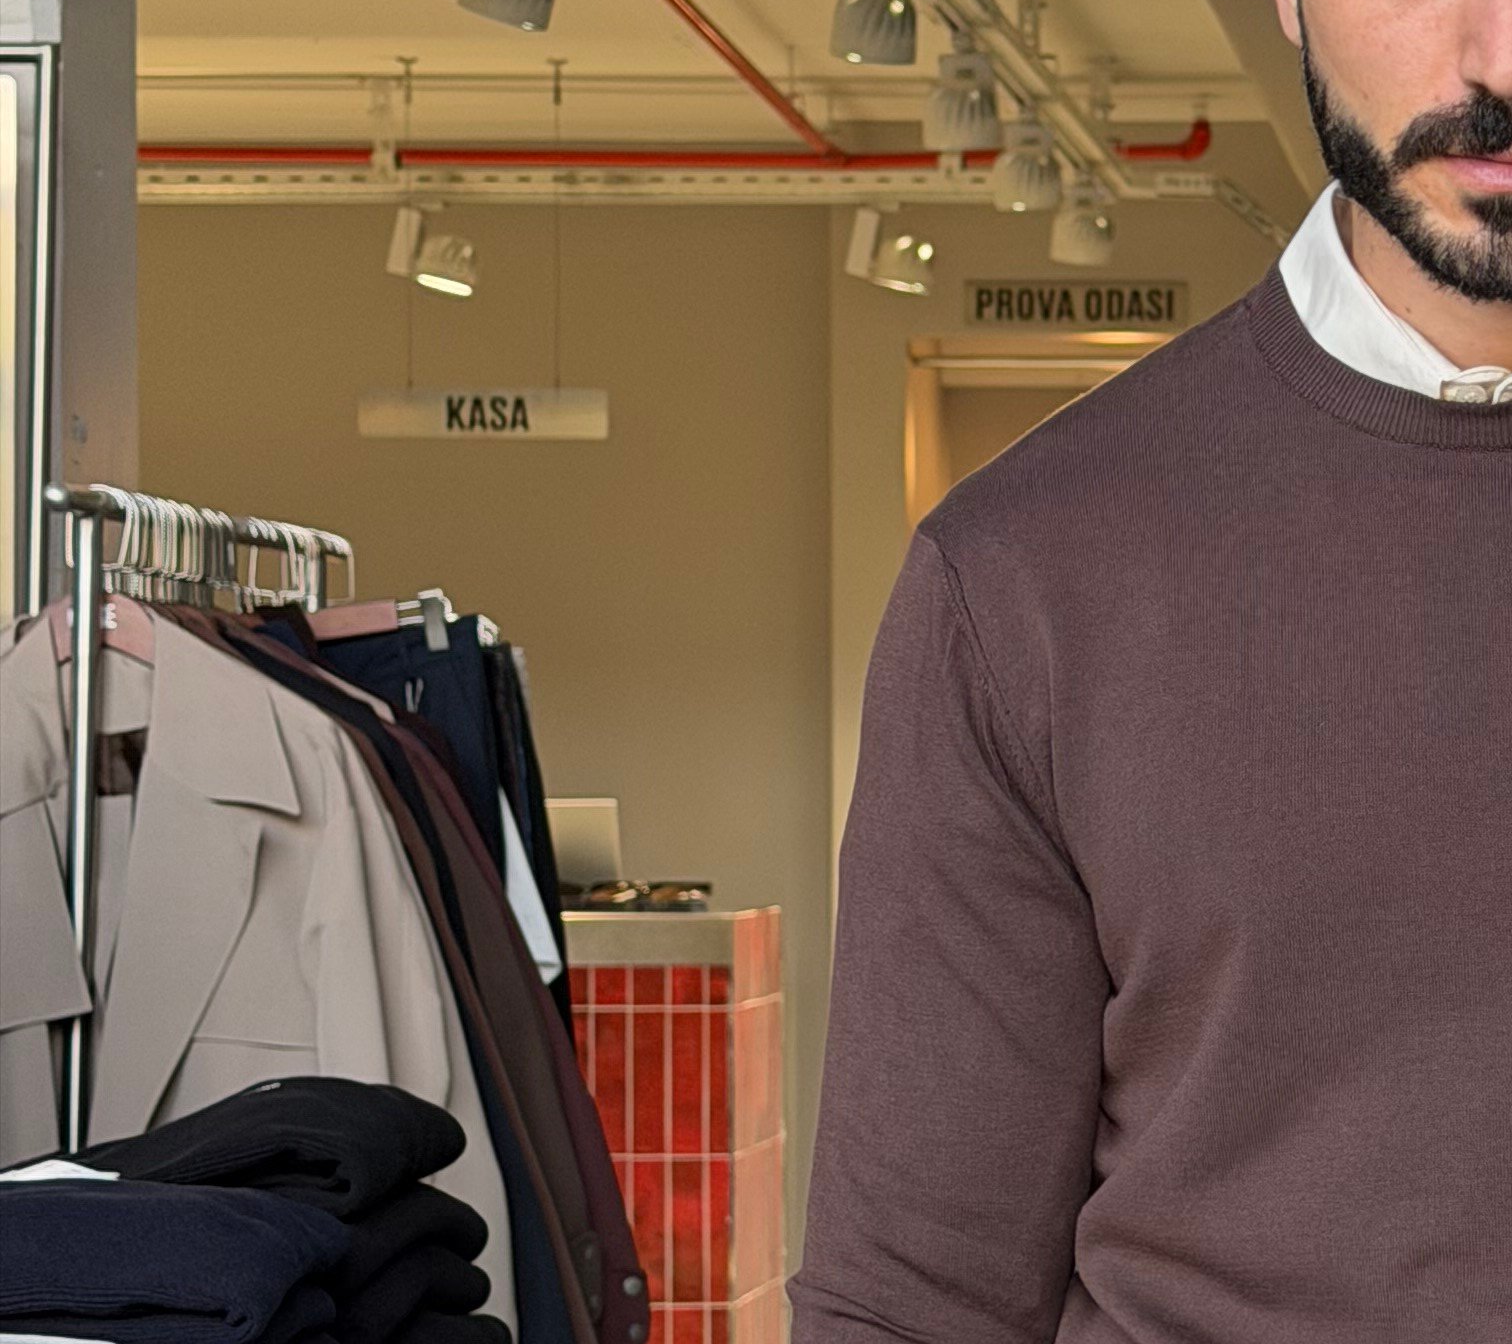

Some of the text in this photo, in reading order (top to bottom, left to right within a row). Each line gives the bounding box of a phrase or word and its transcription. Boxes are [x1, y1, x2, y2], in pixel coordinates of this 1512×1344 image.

[976, 288, 1174, 321] PROVA ODASI
[446, 395, 529, 431] KASA
